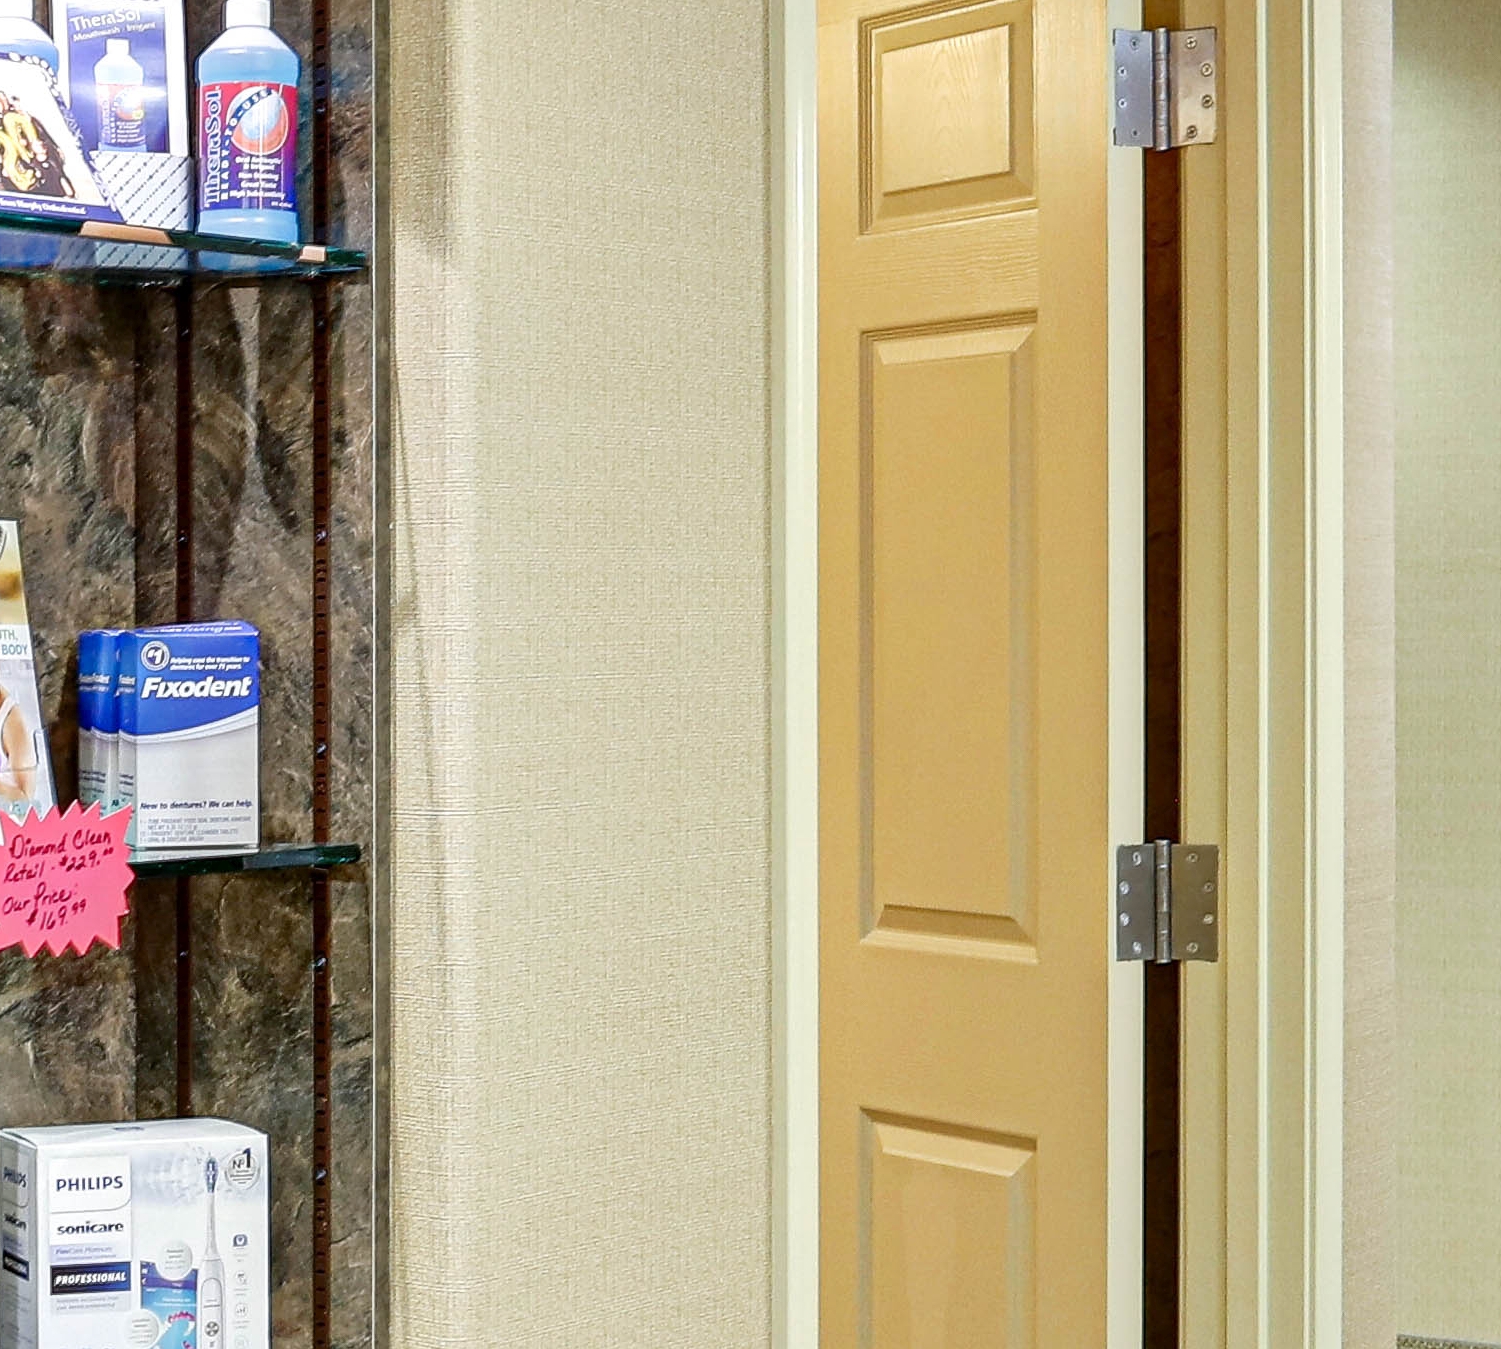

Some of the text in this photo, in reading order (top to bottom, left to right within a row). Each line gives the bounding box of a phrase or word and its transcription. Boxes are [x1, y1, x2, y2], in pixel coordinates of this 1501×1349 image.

[69, 8, 141, 32] TheraSol
[204, 88, 222, 207] TheraSol
[1, 644, 28, 655] BODY
[141, 675, 252, 699] Fixodent
[9, 829, 111, 859] Diamond Clean
[4, 860, 45, 883] Retail
[2, 896, 30, 915] Our
[56, 1176, 123, 1192] PHILIPS
[56, 1220, 124, 1235] sonicare
[55, 1271, 127, 1287] PROFESSIONAL
